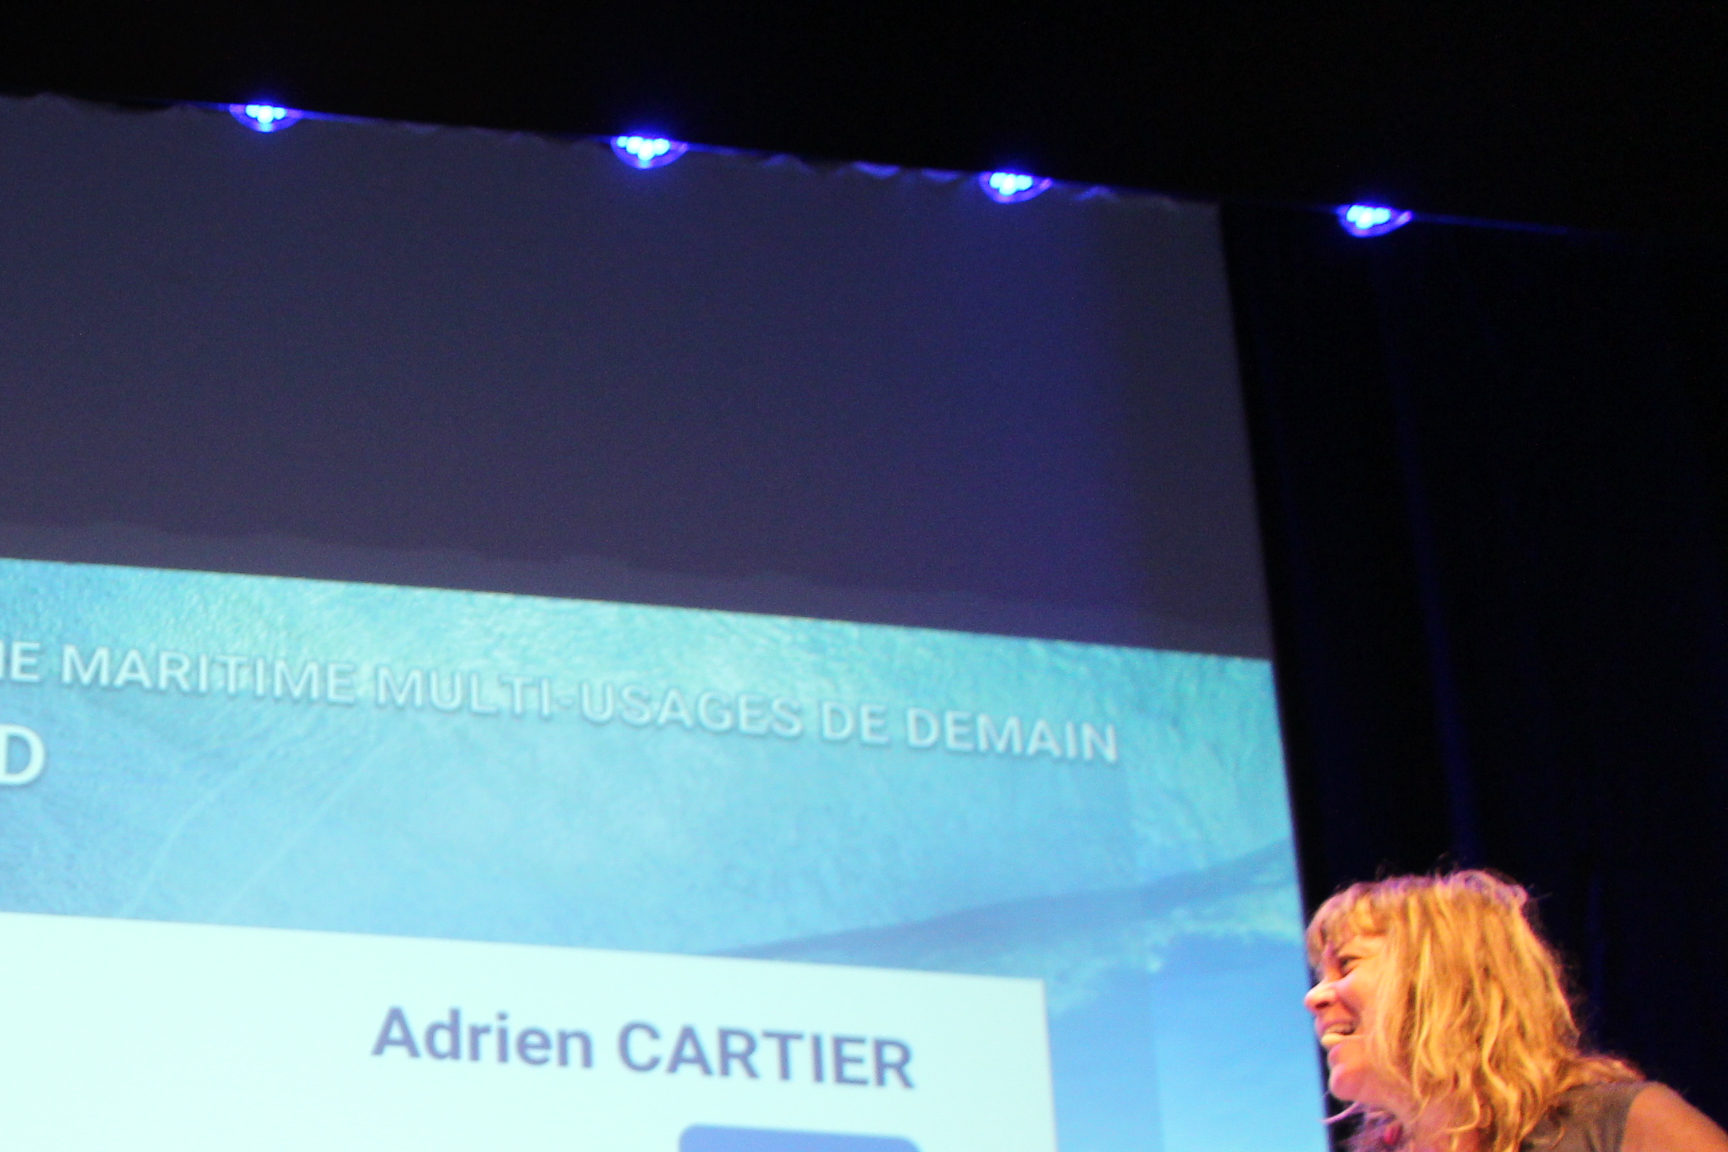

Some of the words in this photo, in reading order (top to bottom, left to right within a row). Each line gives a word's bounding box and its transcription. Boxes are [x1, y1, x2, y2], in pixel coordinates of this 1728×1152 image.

[62, 644, 355, 704] MARITIME
[376, 664, 803, 738] MULTI-USAGES
[822, 702, 889, 746] DE
[907, 707, 1119, 763] DEMAIN
[371, 1005, 595, 1069] Adrien
[617, 1020, 917, 1089] CARTIER
